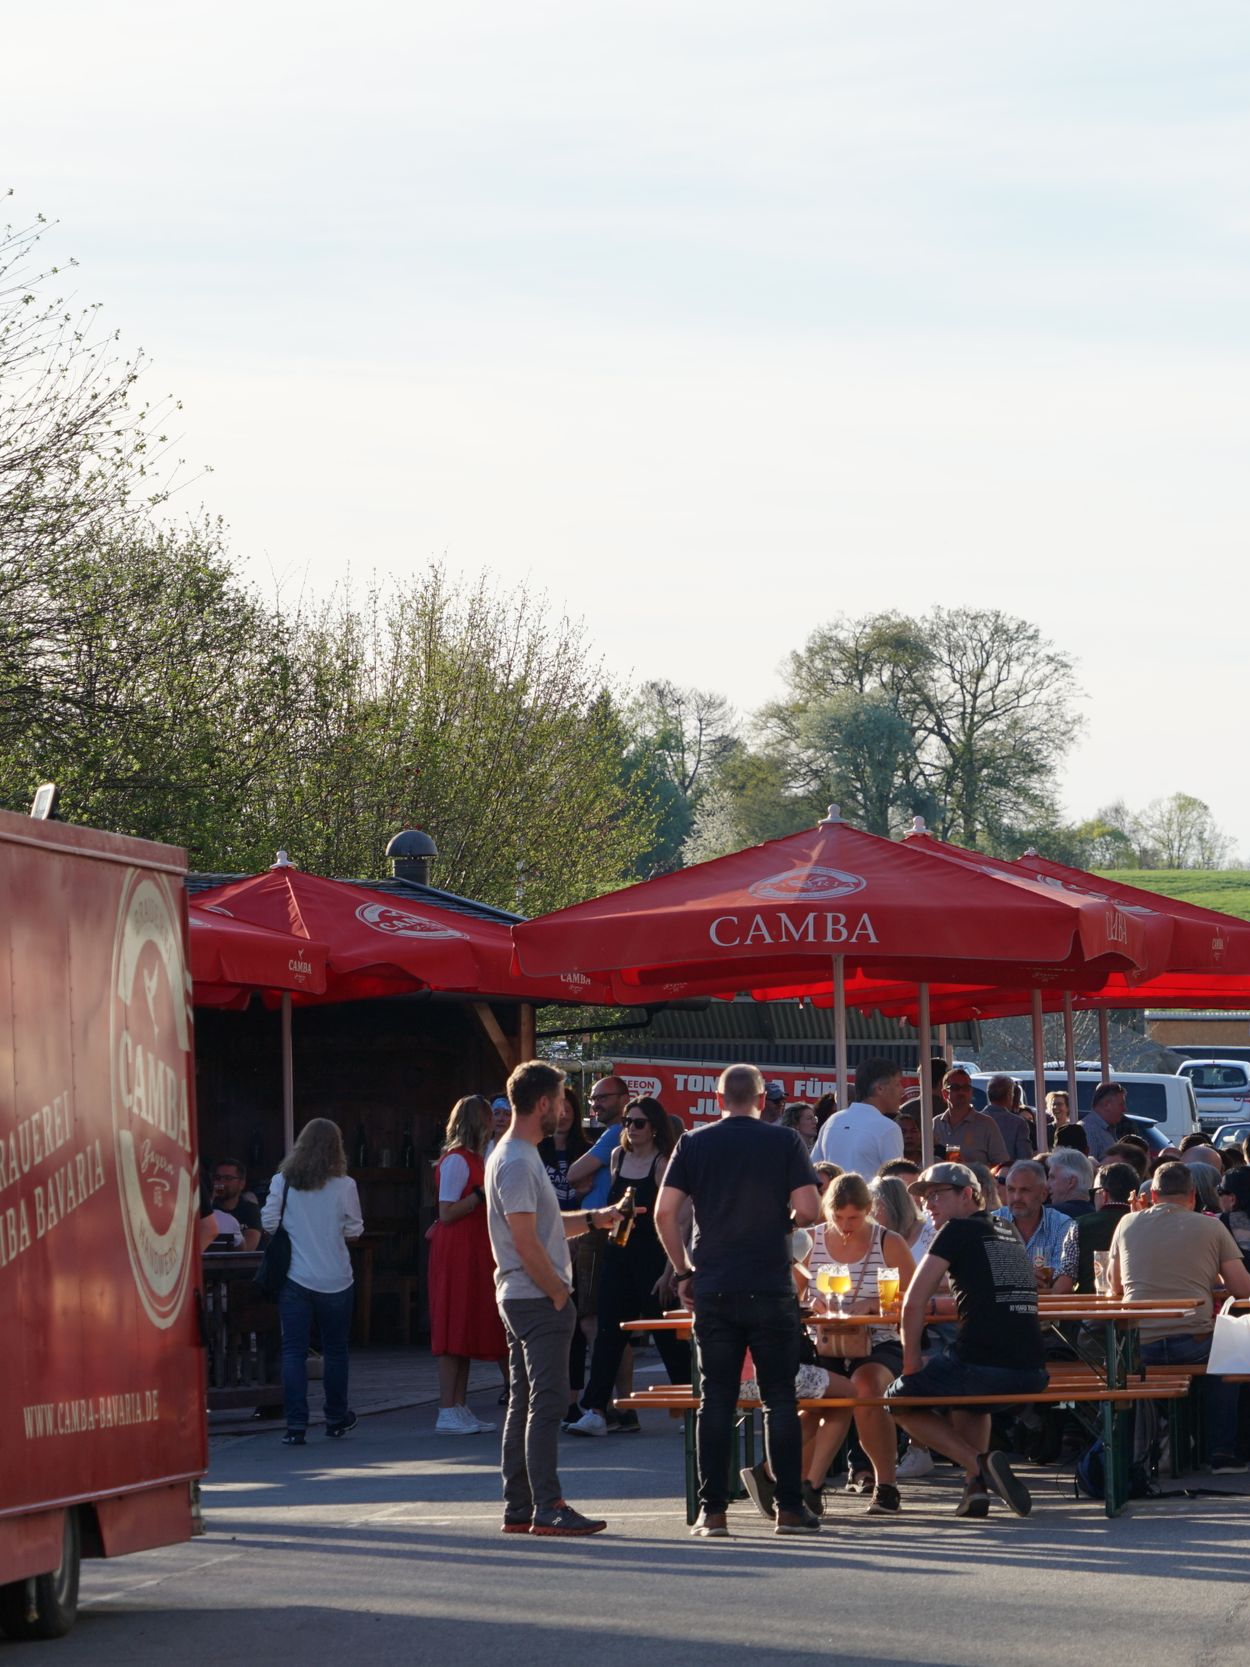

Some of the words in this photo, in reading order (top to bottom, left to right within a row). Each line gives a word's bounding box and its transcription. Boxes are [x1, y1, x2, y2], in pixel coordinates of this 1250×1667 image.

[709, 912, 880, 947] CAMBA
[288, 959, 312, 974] CAMBA
[119, 1029, 192, 1153] CAMBA
[34, 1138, 105, 1240] BAVARIA
[23, 1390, 159, 1440] WWW.CAMBA-BAVARIA.DE
